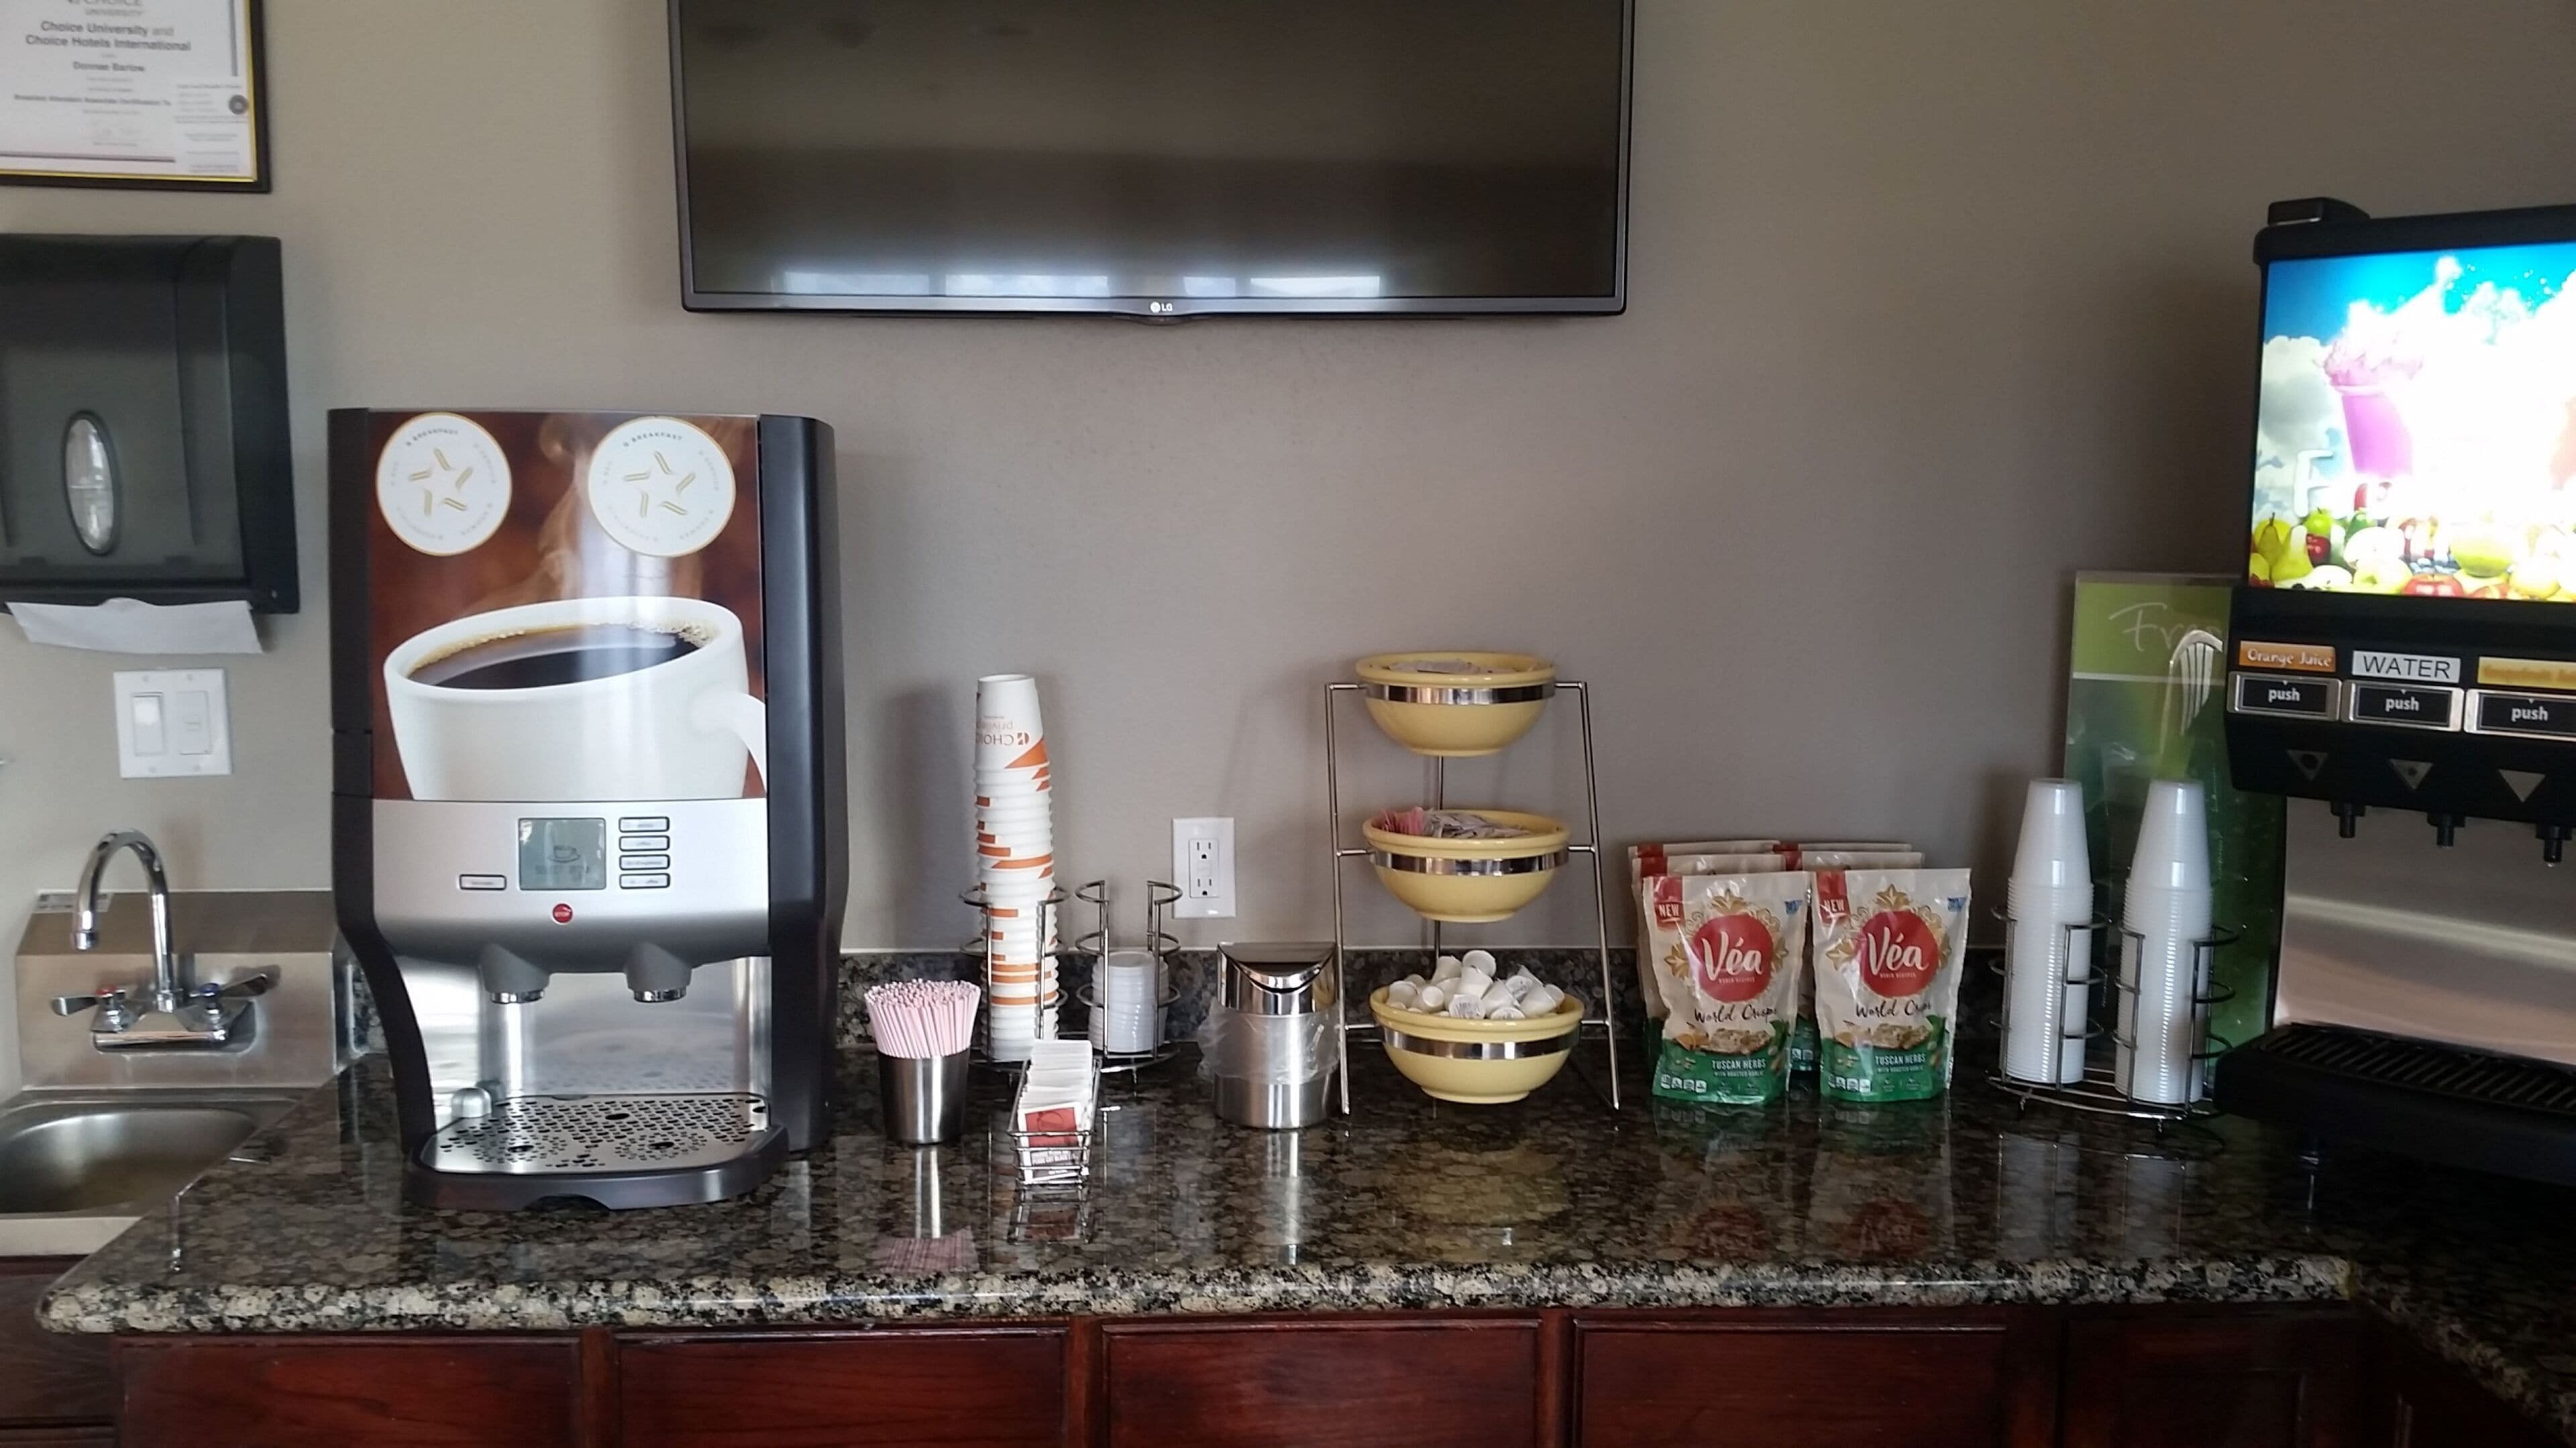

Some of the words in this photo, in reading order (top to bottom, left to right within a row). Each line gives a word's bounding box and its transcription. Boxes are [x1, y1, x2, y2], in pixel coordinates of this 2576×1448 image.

[41, 21, 83, 32] Choice
[87, 23, 148, 37] University
[152, 27, 174, 36] and
[25, 35, 68, 46] Choice
[72, 38, 110, 48] Hotels
[115, 39, 191, 51] International
[1161, 303, 1173, 312] LG
[2247, 649, 2294, 666] Orange
[2299, 651, 2332, 667] Juice
[2363, 655, 2451, 679] WATER
[2268, 687, 2300, 703] push
[2385, 696, 2420, 712] push
[2511, 706, 2548, 722] push
[1658, 903, 1680, 917] NEW
[1824, 898, 1844, 912] NEW
[1701, 931, 1762, 981] Véa
[1867, 926, 1929, 976] Véa
[1694, 1004, 1735, 1023] World
[1856, 999, 1898, 1018] World
[1712, 1060, 1741, 1070] TUSCAN
[1743, 1058, 1766, 1069] HERBS
[1875, 1055, 1904, 1065] TUSCAN
[1904, 1053, 1926, 1064] HERBS
